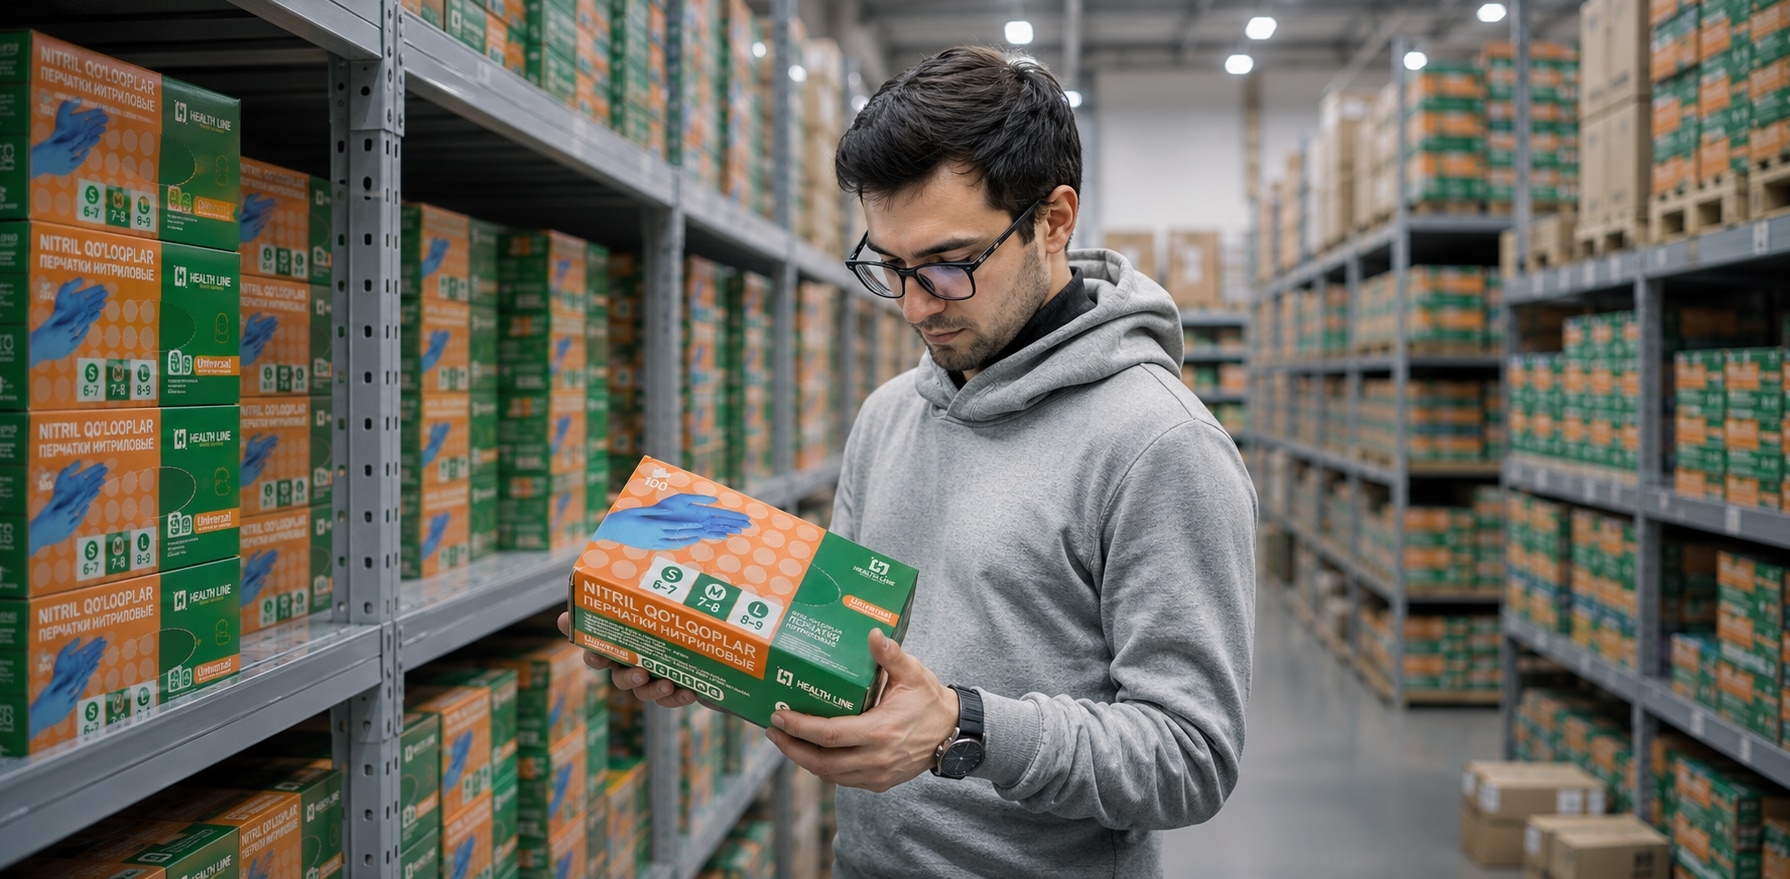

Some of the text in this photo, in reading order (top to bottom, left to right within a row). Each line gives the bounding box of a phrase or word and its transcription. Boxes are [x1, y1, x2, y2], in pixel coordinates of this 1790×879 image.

[41, 46, 82, 73] NITRIL
[190, 110, 215, 127] HEALTH
[88, 189, 96, 202] S
[141, 202, 147, 212] L
[83, 206, 99, 219] 6-7
[111, 210, 126, 222] 7-8
[40, 233, 81, 255] NITRIL
[40, 254, 91, 272] ПЕРЧАТКИ
[190, 272, 215, 285] HEALTH
[88, 366, 96, 380] S
[141, 369, 147, 380] L
[83, 384, 150, 396] 6-7 7-8 8-9
[39, 422, 81, 440] NITRIL
[190, 430, 231, 444] HEALTH LINE
[39, 442, 90, 458] ПЕРЧАТКИ
[644, 477, 668, 491] 100
[88, 537, 147, 558] S M L
[83, 553, 151, 575] 6-7 7-8 8-9
[189, 587, 215, 604] HEALTH
[583, 580, 639, 613] NITRIL
[666, 569, 762, 616] S M L
[38, 602, 81, 625] NITRIL
[652, 580, 763, 630] 6-7 7-8 8-9
[38, 619, 90, 642] ПЕРЧАТКИ
[583, 595, 657, 632] ПЕРЧАТКИ
[661, 624, 755, 671] НИТРИЛОВЫЕ
[88, 705, 96, 719] S
[141, 691, 147, 704] L
[797, 680, 854, 710] HEALTH LINE
